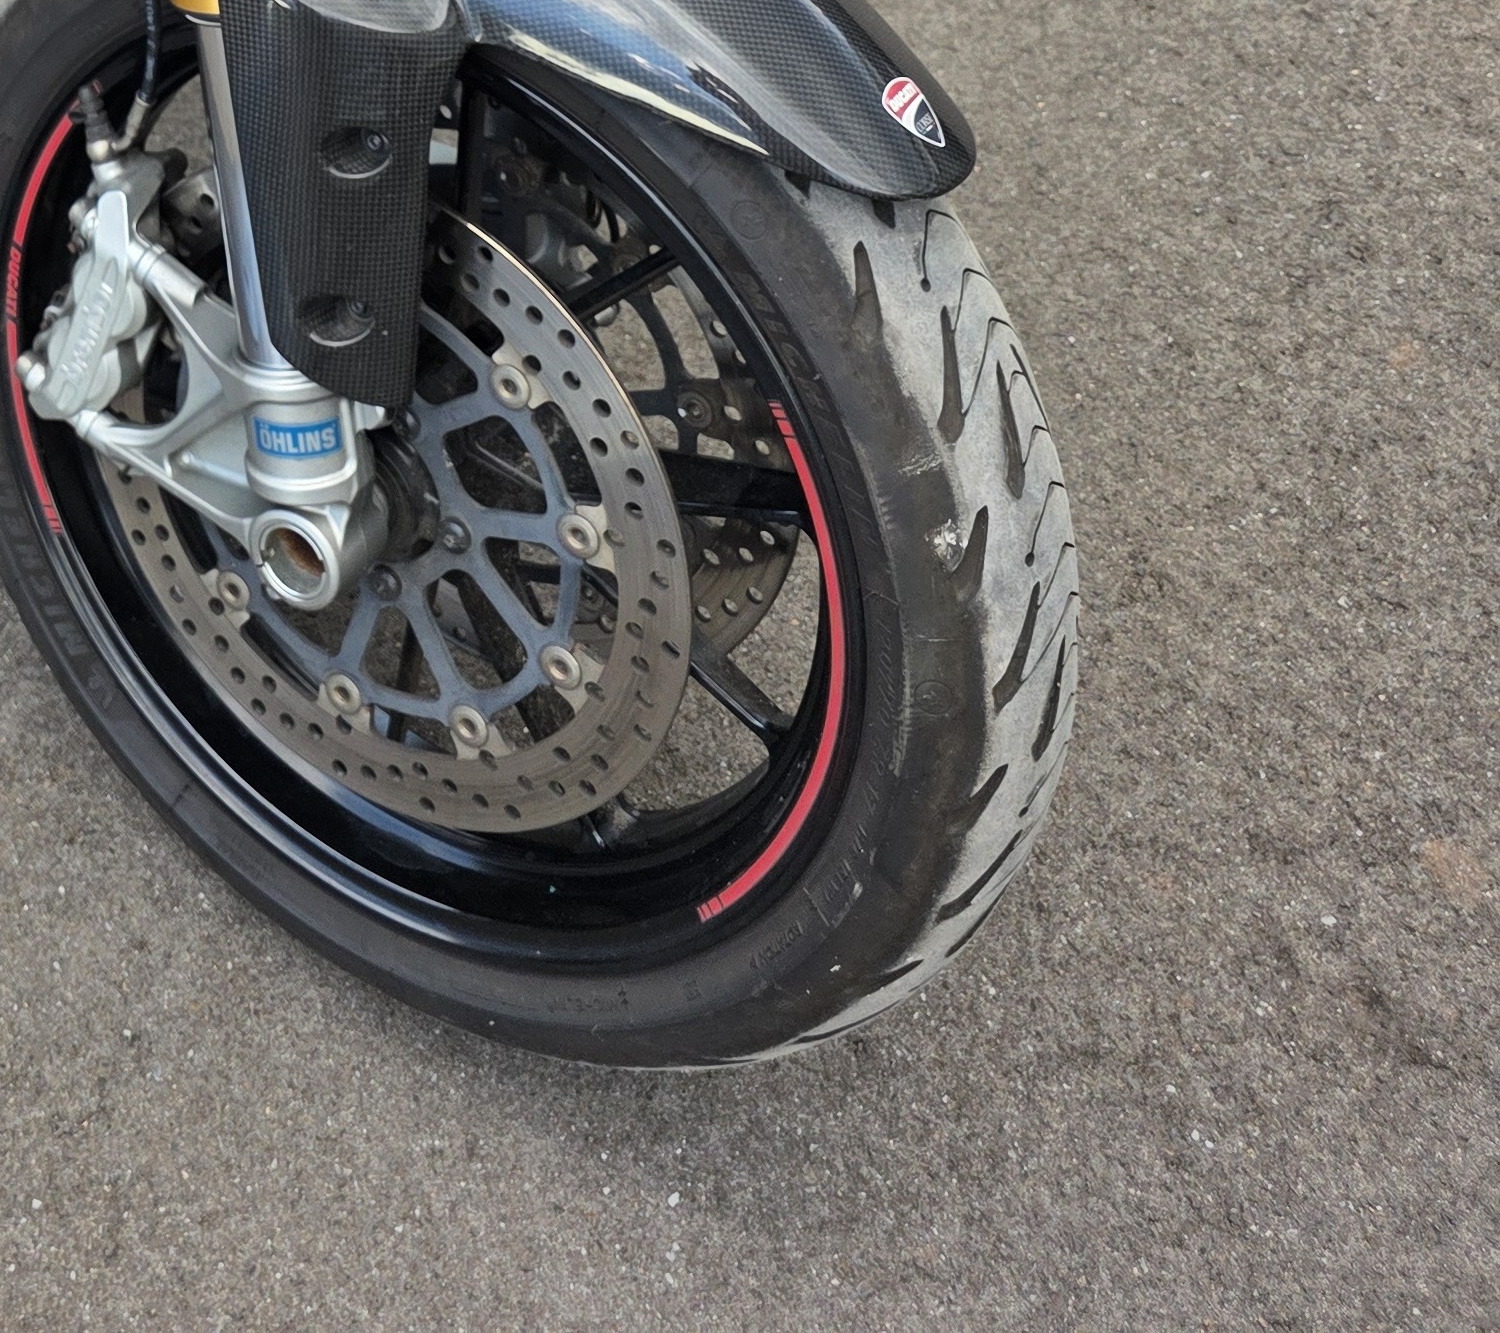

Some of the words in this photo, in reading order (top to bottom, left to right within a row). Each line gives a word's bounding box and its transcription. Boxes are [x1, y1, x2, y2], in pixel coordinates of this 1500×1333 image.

[887, 82, 917, 113] DUCATI
[6, 246, 22, 317] DUCATI
[259, 423, 337, 453] ÖHLINS
